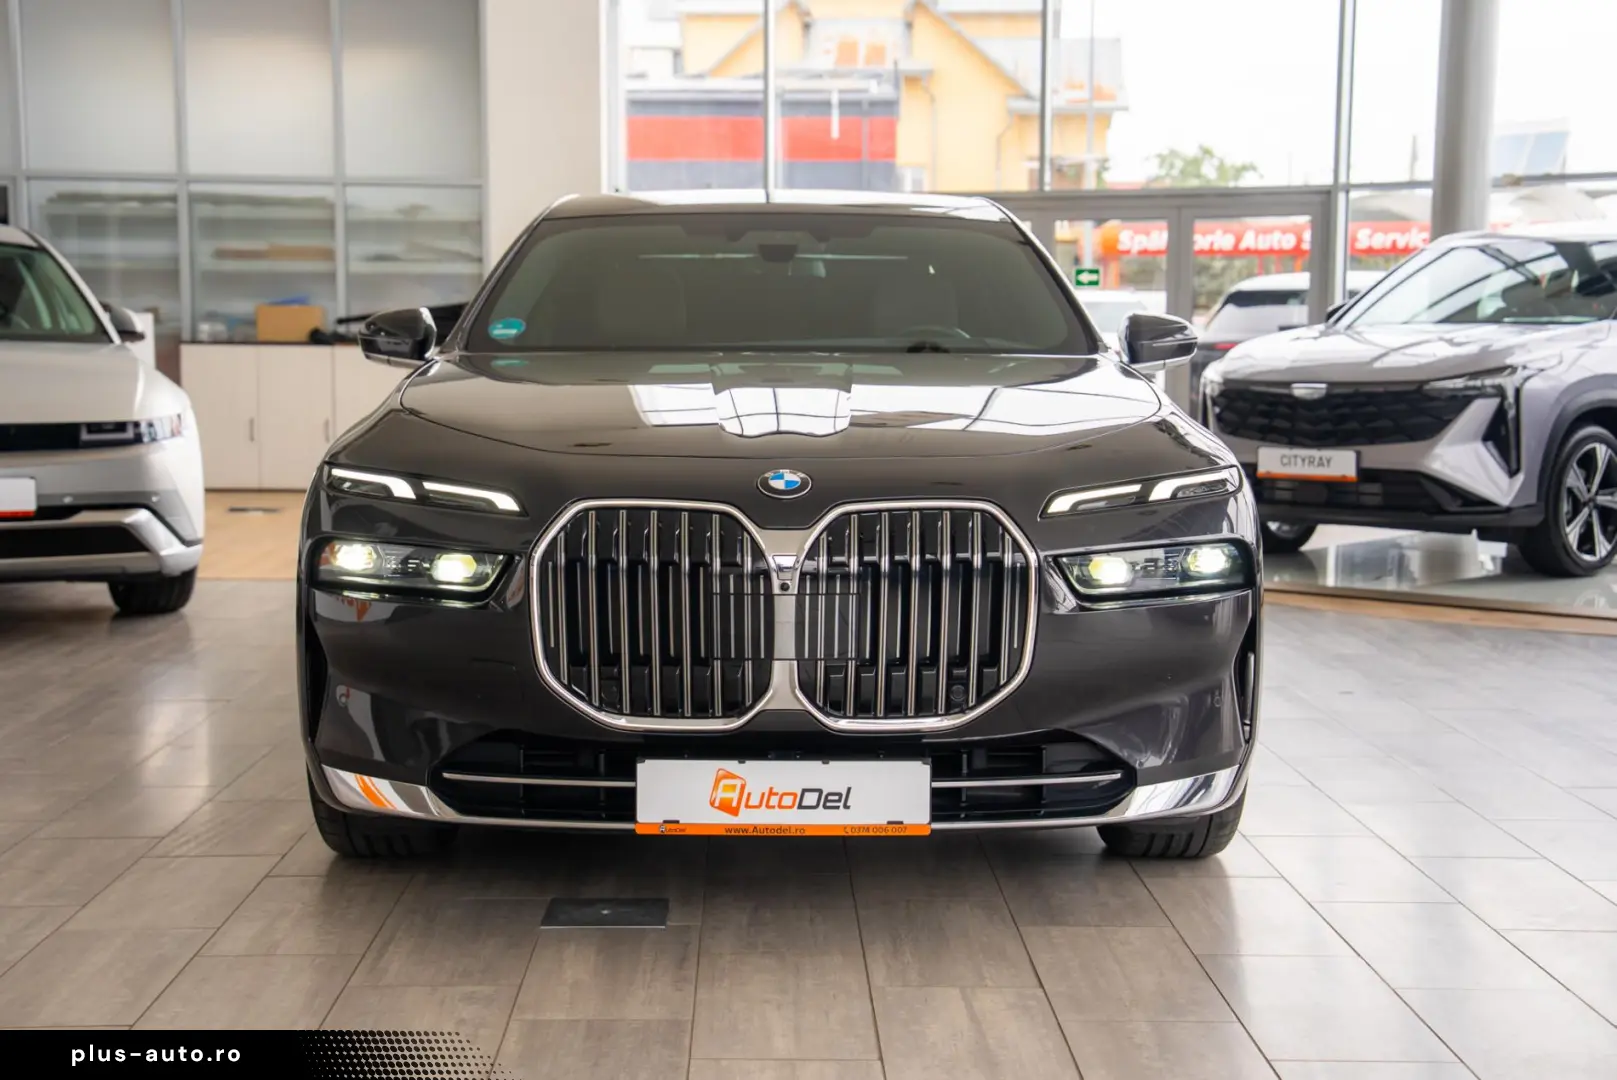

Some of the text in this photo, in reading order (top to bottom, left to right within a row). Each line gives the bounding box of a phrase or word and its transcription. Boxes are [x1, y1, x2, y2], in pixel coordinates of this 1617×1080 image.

[1238, 229, 1297, 250] Auto
[1355, 227, 1431, 250] Servic
[1280, 454, 1333, 468] CITYRAY
[712, 775, 852, 812] AutoDel
[724, 825, 806, 835] www.Autodel.ro
